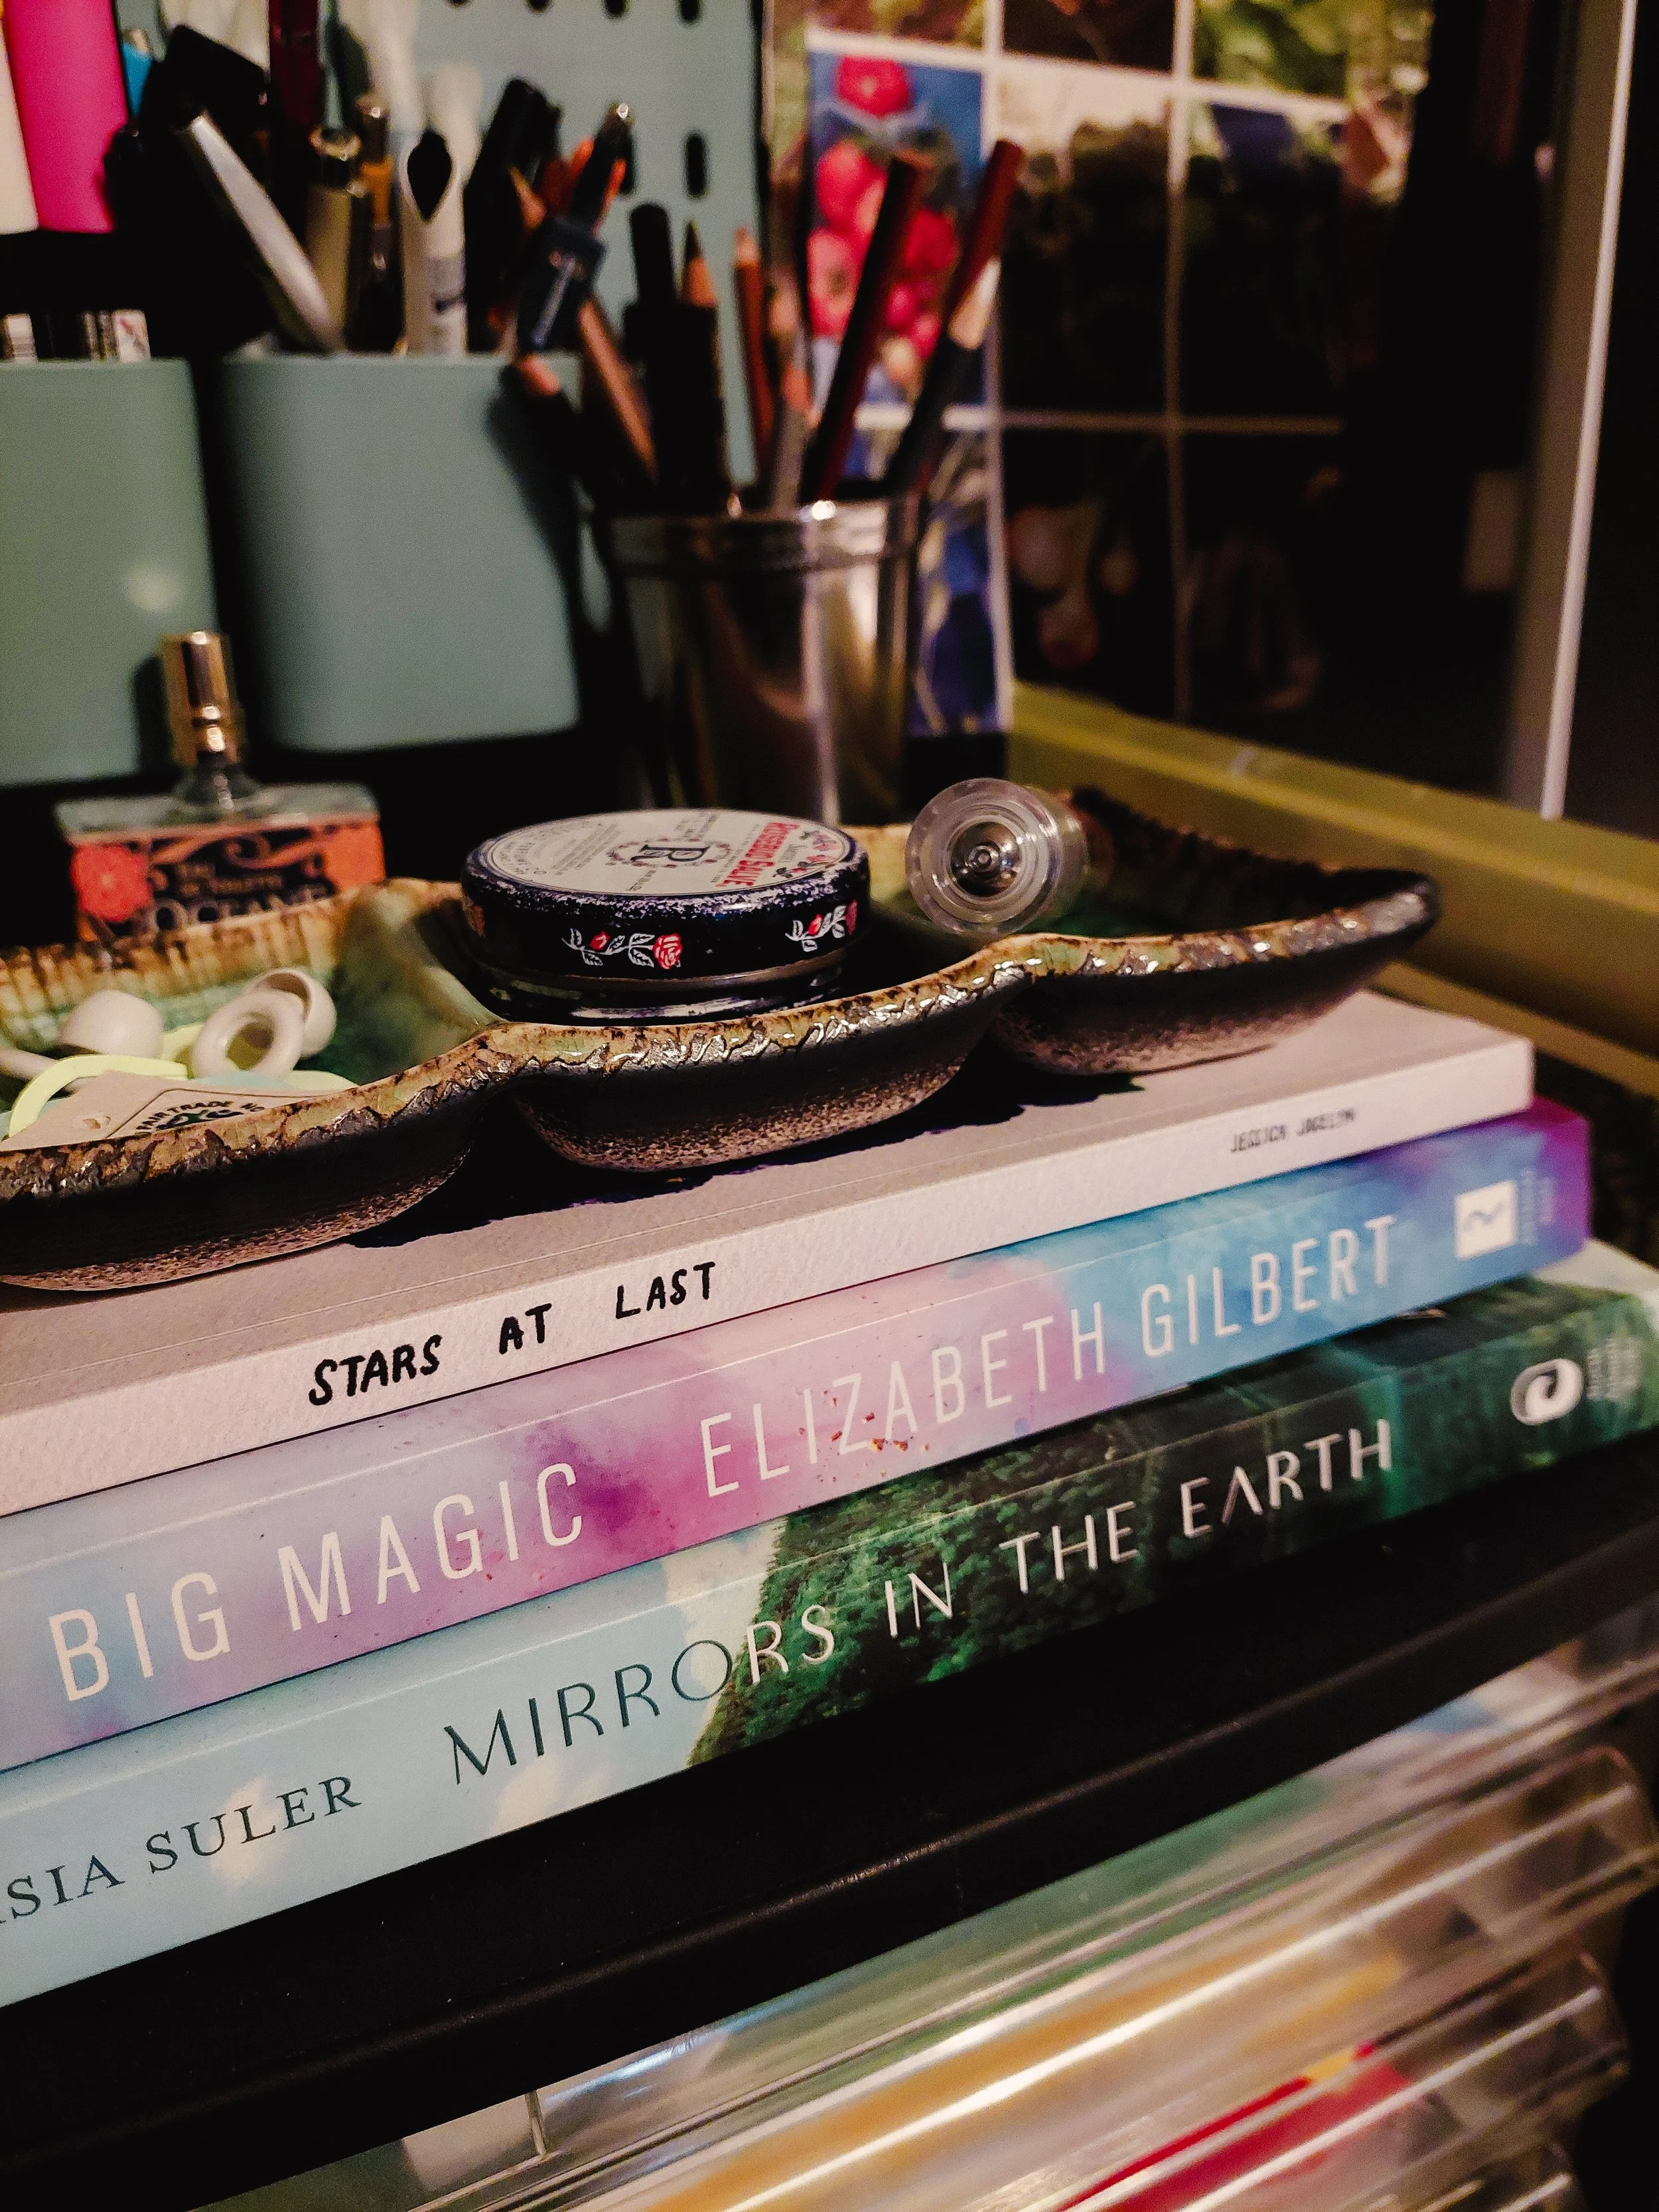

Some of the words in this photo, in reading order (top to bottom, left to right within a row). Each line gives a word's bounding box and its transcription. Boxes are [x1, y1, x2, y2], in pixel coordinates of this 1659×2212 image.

[167, 1100, 234, 1113] TRADE
[48, 1572, 232, 1702] BIG
[277, 1463, 583, 1632] MAGIC
[701, 1301, 1106, 1497] ELIZABETH
[1141, 1215, 1396, 1357] GILBERT
[309, 1333, 443, 1406] STARS
[499, 1303, 552, 1354] AT
[614, 1262, 717, 1319] LAST
[0, 1855, 126, 1924] SIA
[144, 1775, 362, 1874] SULER
[443, 1604, 835, 1785] MIRRORS
[885, 1563, 954, 1639] IN
[999, 1501, 1138, 1593] THE
[1181, 1418, 1392, 1539] EARTH
